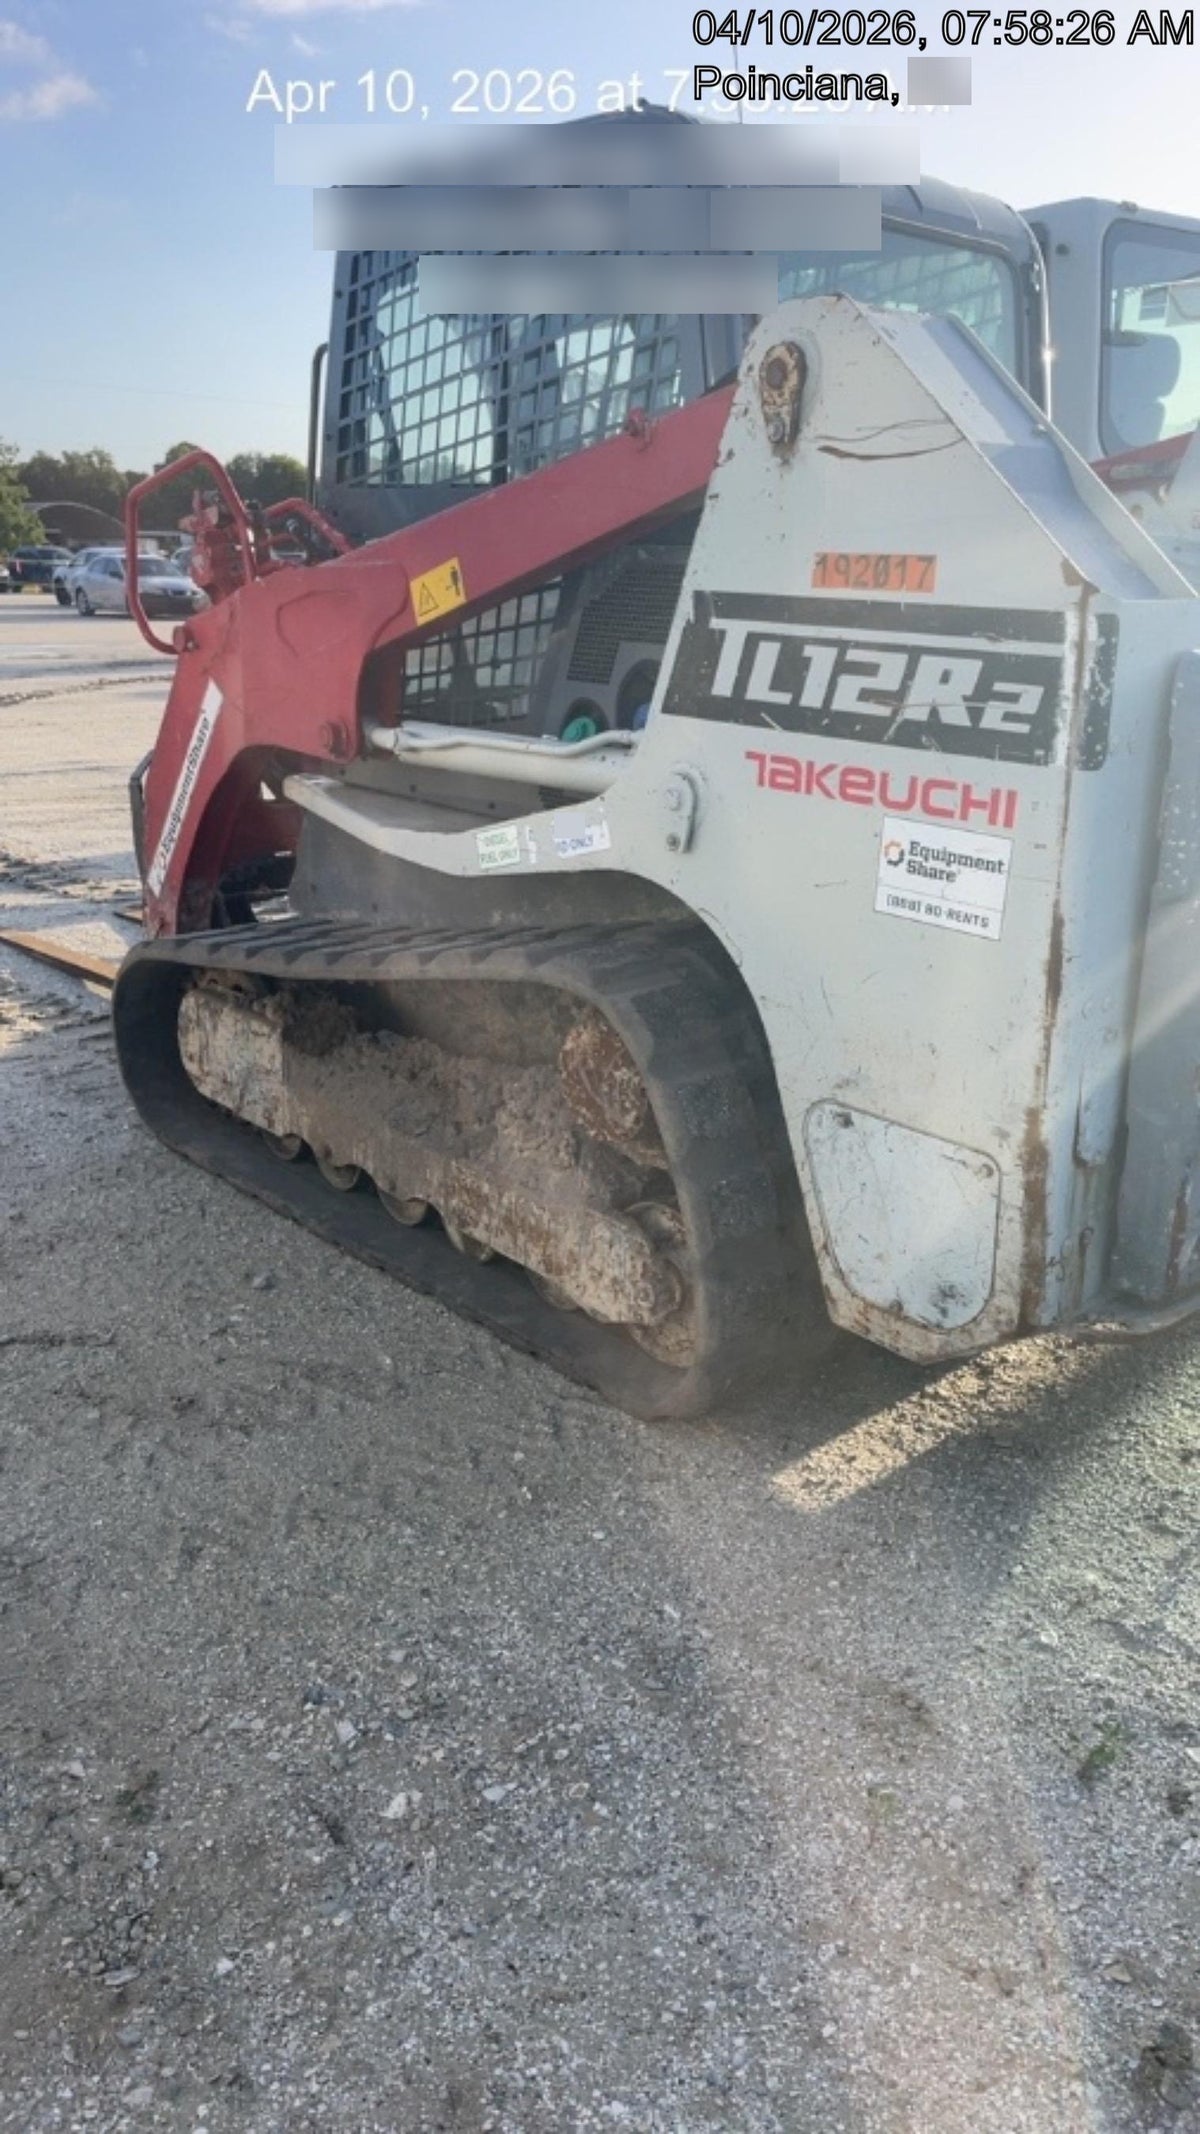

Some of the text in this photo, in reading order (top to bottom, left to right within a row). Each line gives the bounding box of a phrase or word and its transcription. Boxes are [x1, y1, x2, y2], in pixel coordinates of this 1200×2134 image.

[814, 553, 937, 590] 192017
[906, 860, 957, 883] Share
[908, 841, 1005, 875] Equipment
